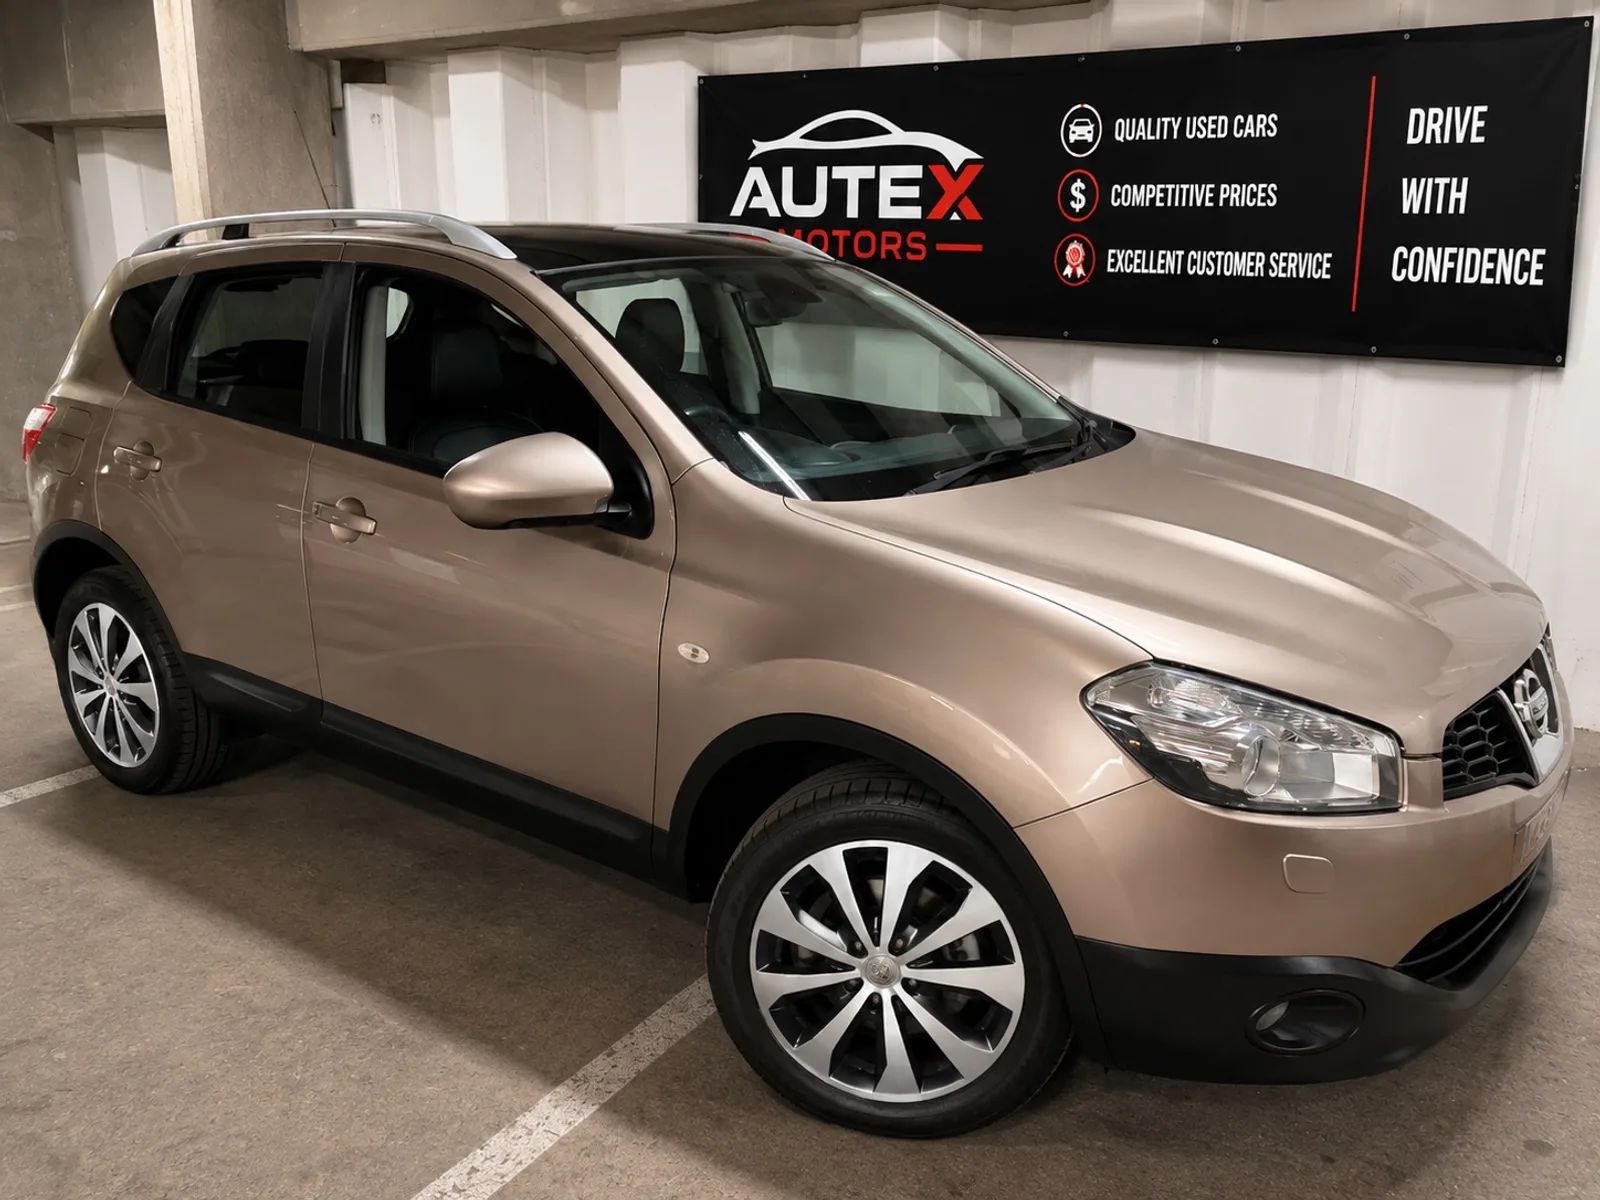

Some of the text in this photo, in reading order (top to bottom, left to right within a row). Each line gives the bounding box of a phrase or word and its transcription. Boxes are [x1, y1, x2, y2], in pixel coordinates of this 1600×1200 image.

[1114, 112, 1279, 143] QUALITY USED CARS
[1406, 104, 1489, 145] DRIVE
[729, 163, 985, 221] AUTEX
[1110, 183, 1278, 207] COMPETITIVE PRICES
[1401, 176, 1469, 215] WITH
[1106, 248, 1333, 280] EXCELLENT CUSTOMER SERVICE
[1391, 245, 1547, 286] CONFIDENCE
